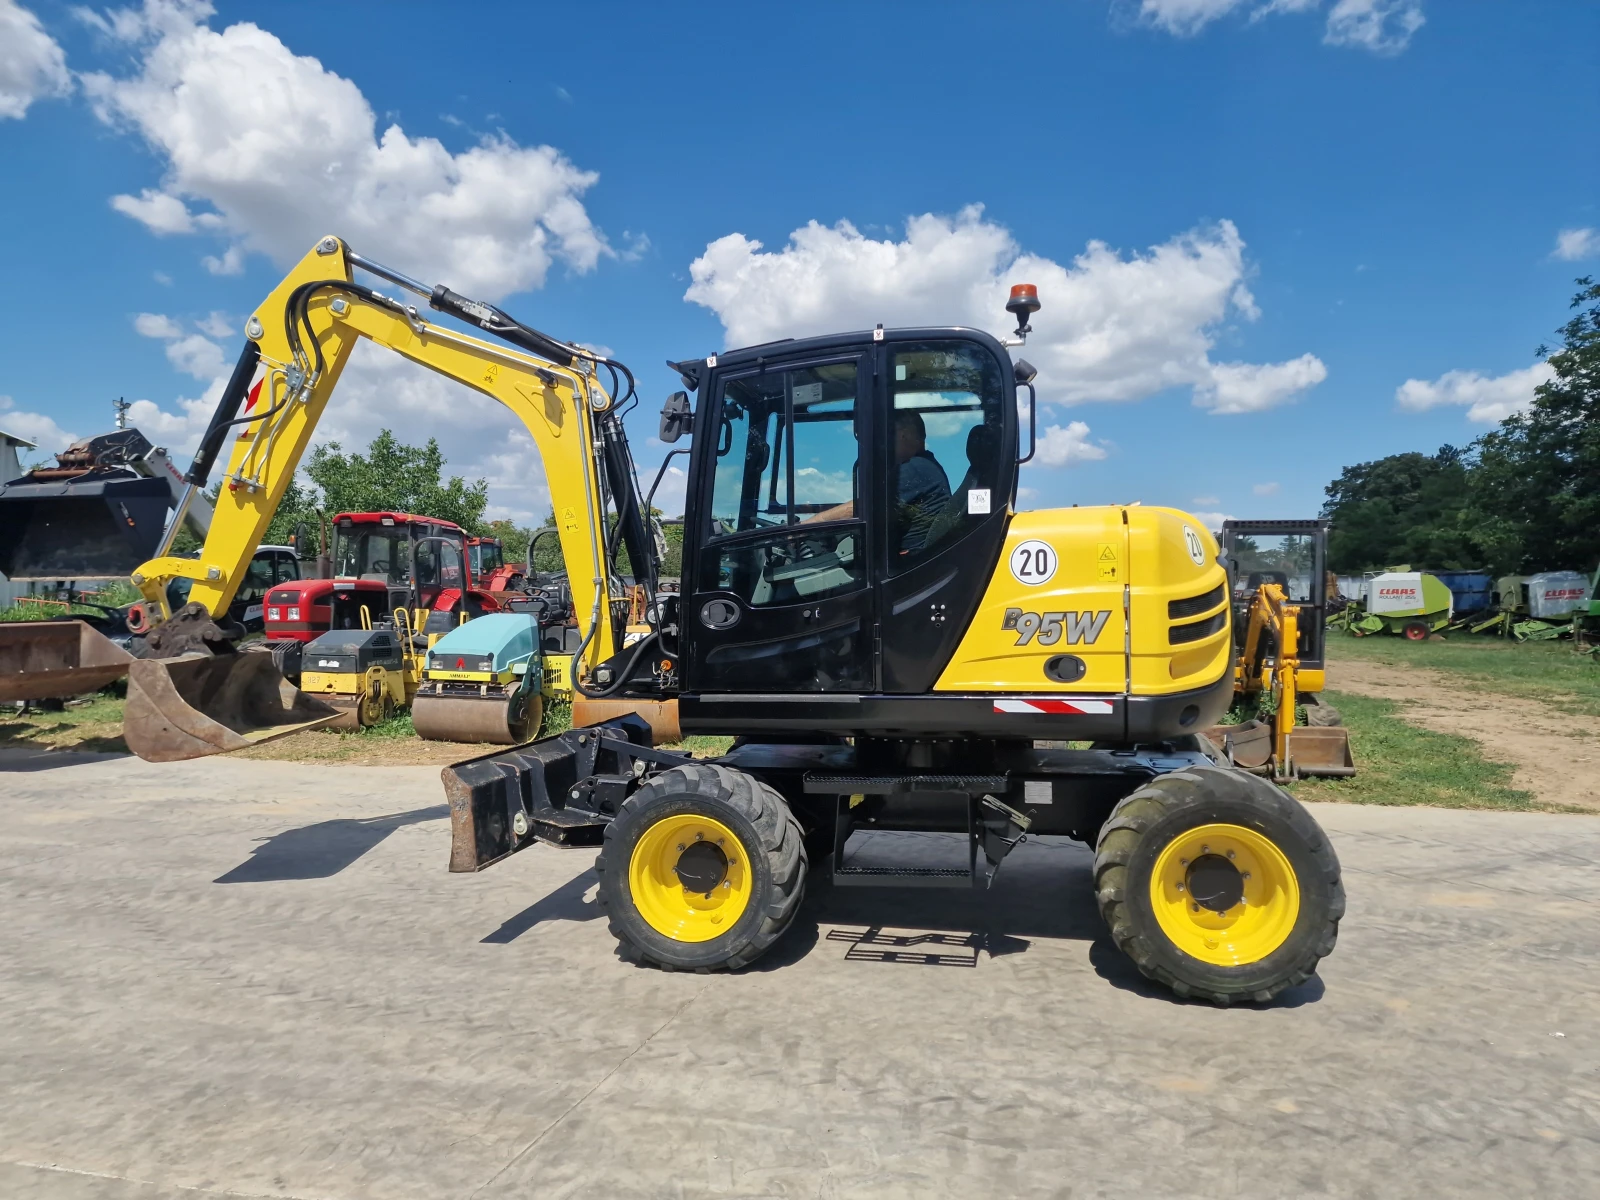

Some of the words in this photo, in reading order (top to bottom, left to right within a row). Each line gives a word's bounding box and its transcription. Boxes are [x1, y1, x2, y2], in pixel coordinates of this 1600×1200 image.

[1187, 532, 1202, 557] 20
[1019, 549, 1047, 576] 20
[1545, 588, 1584, 597] CLAAS
[1001, 608, 1112, 646] B95W
